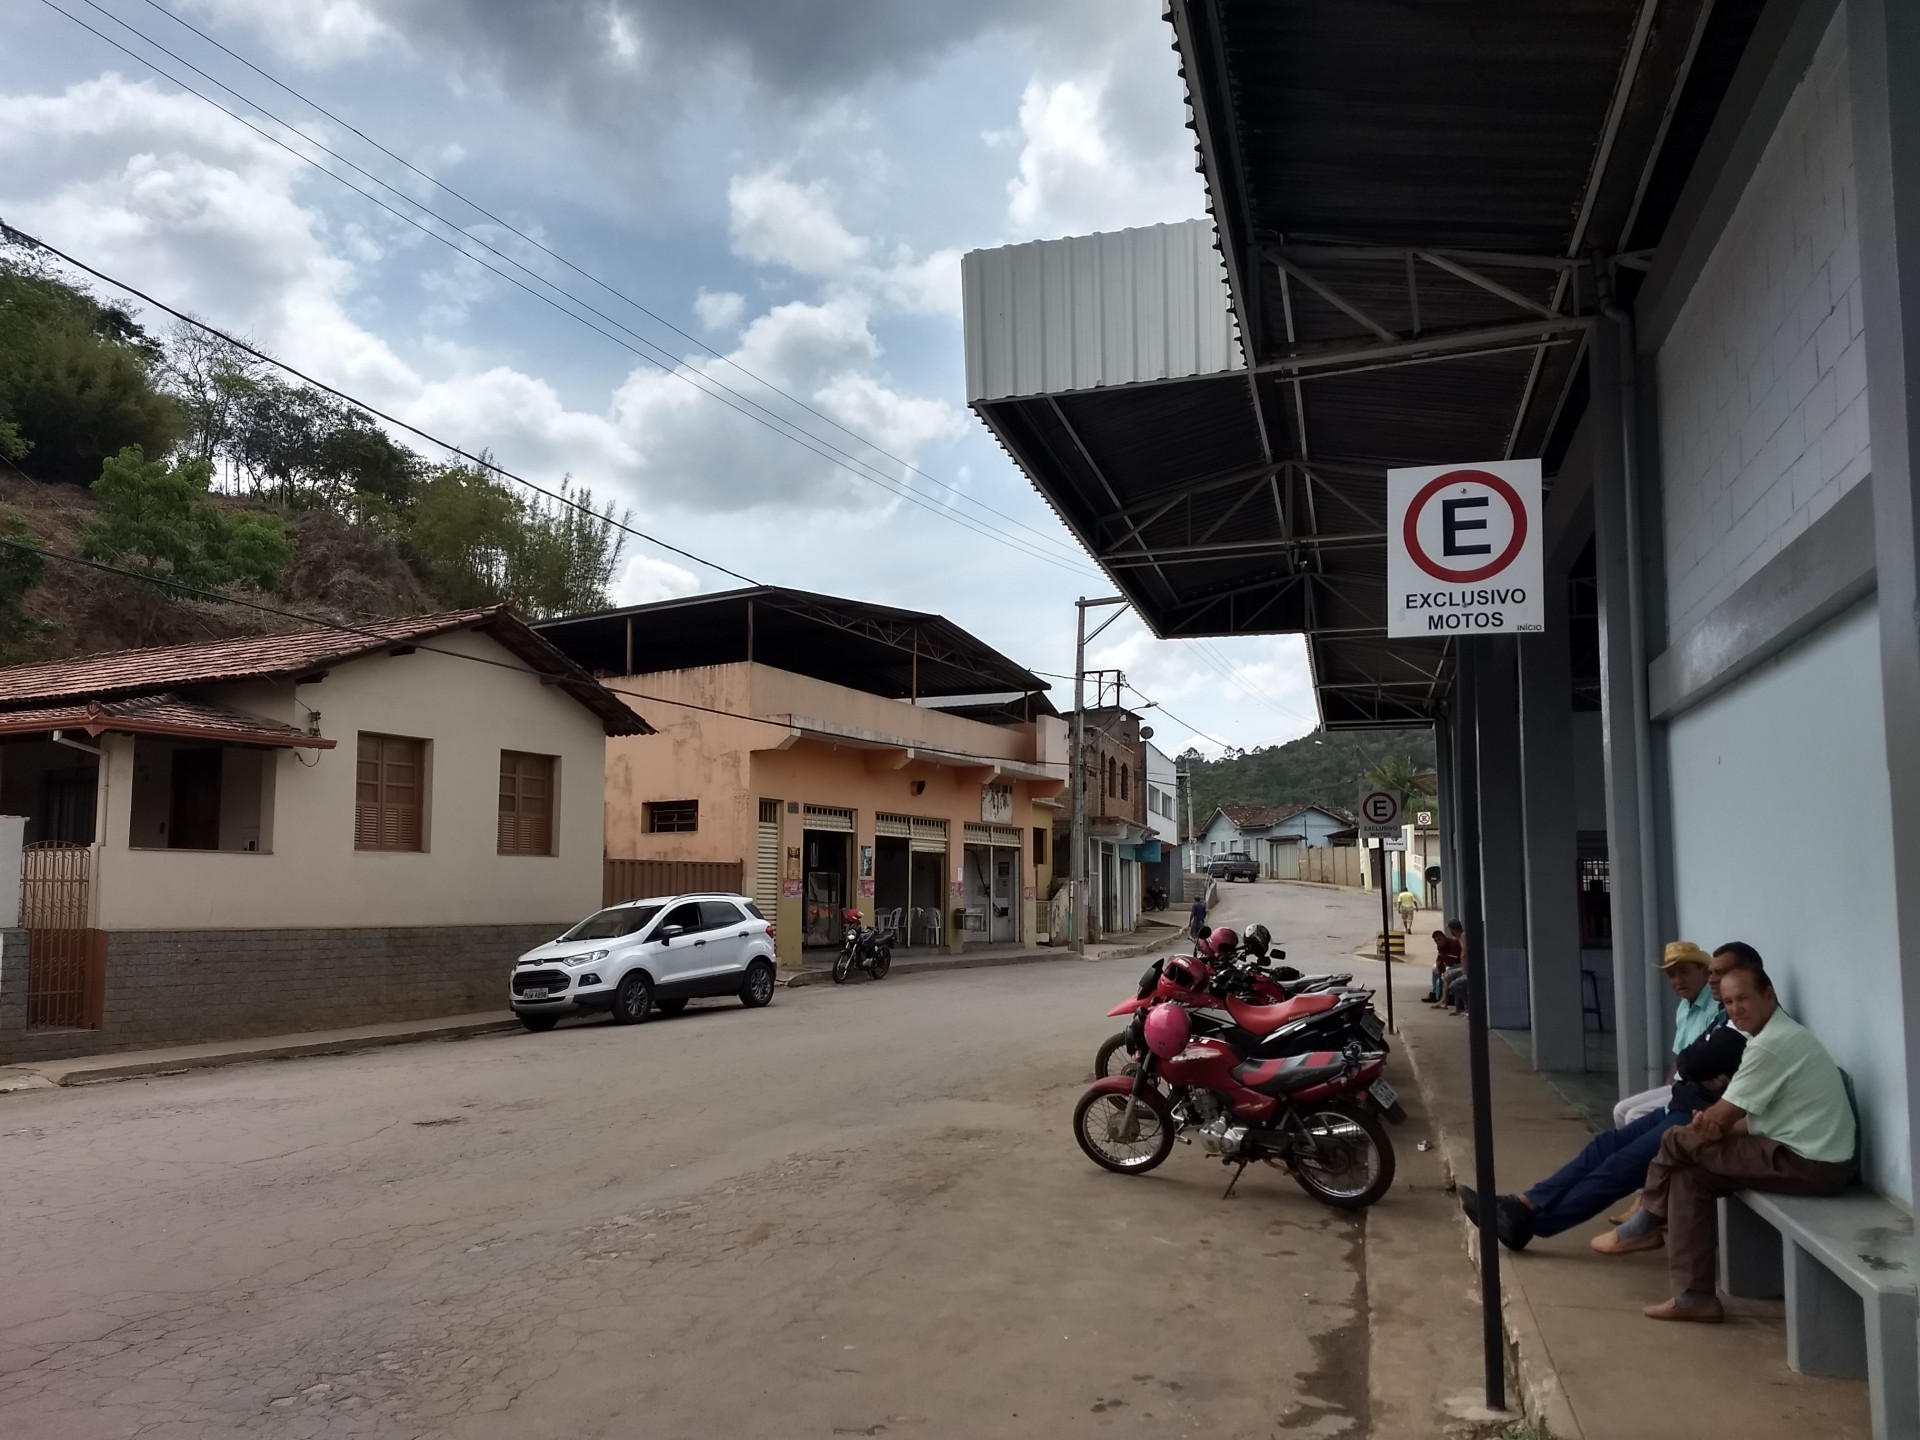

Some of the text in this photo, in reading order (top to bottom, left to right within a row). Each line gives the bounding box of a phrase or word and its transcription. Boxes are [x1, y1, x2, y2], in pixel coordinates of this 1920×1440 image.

[1442, 496, 1491, 557] E
[1405, 588, 1527, 609] EXCLUSIVO
[1428, 612, 1504, 631] MOTOS
[1517, 623, 1542, 632] INÍCIO
[1373, 800, 1388, 817] E
